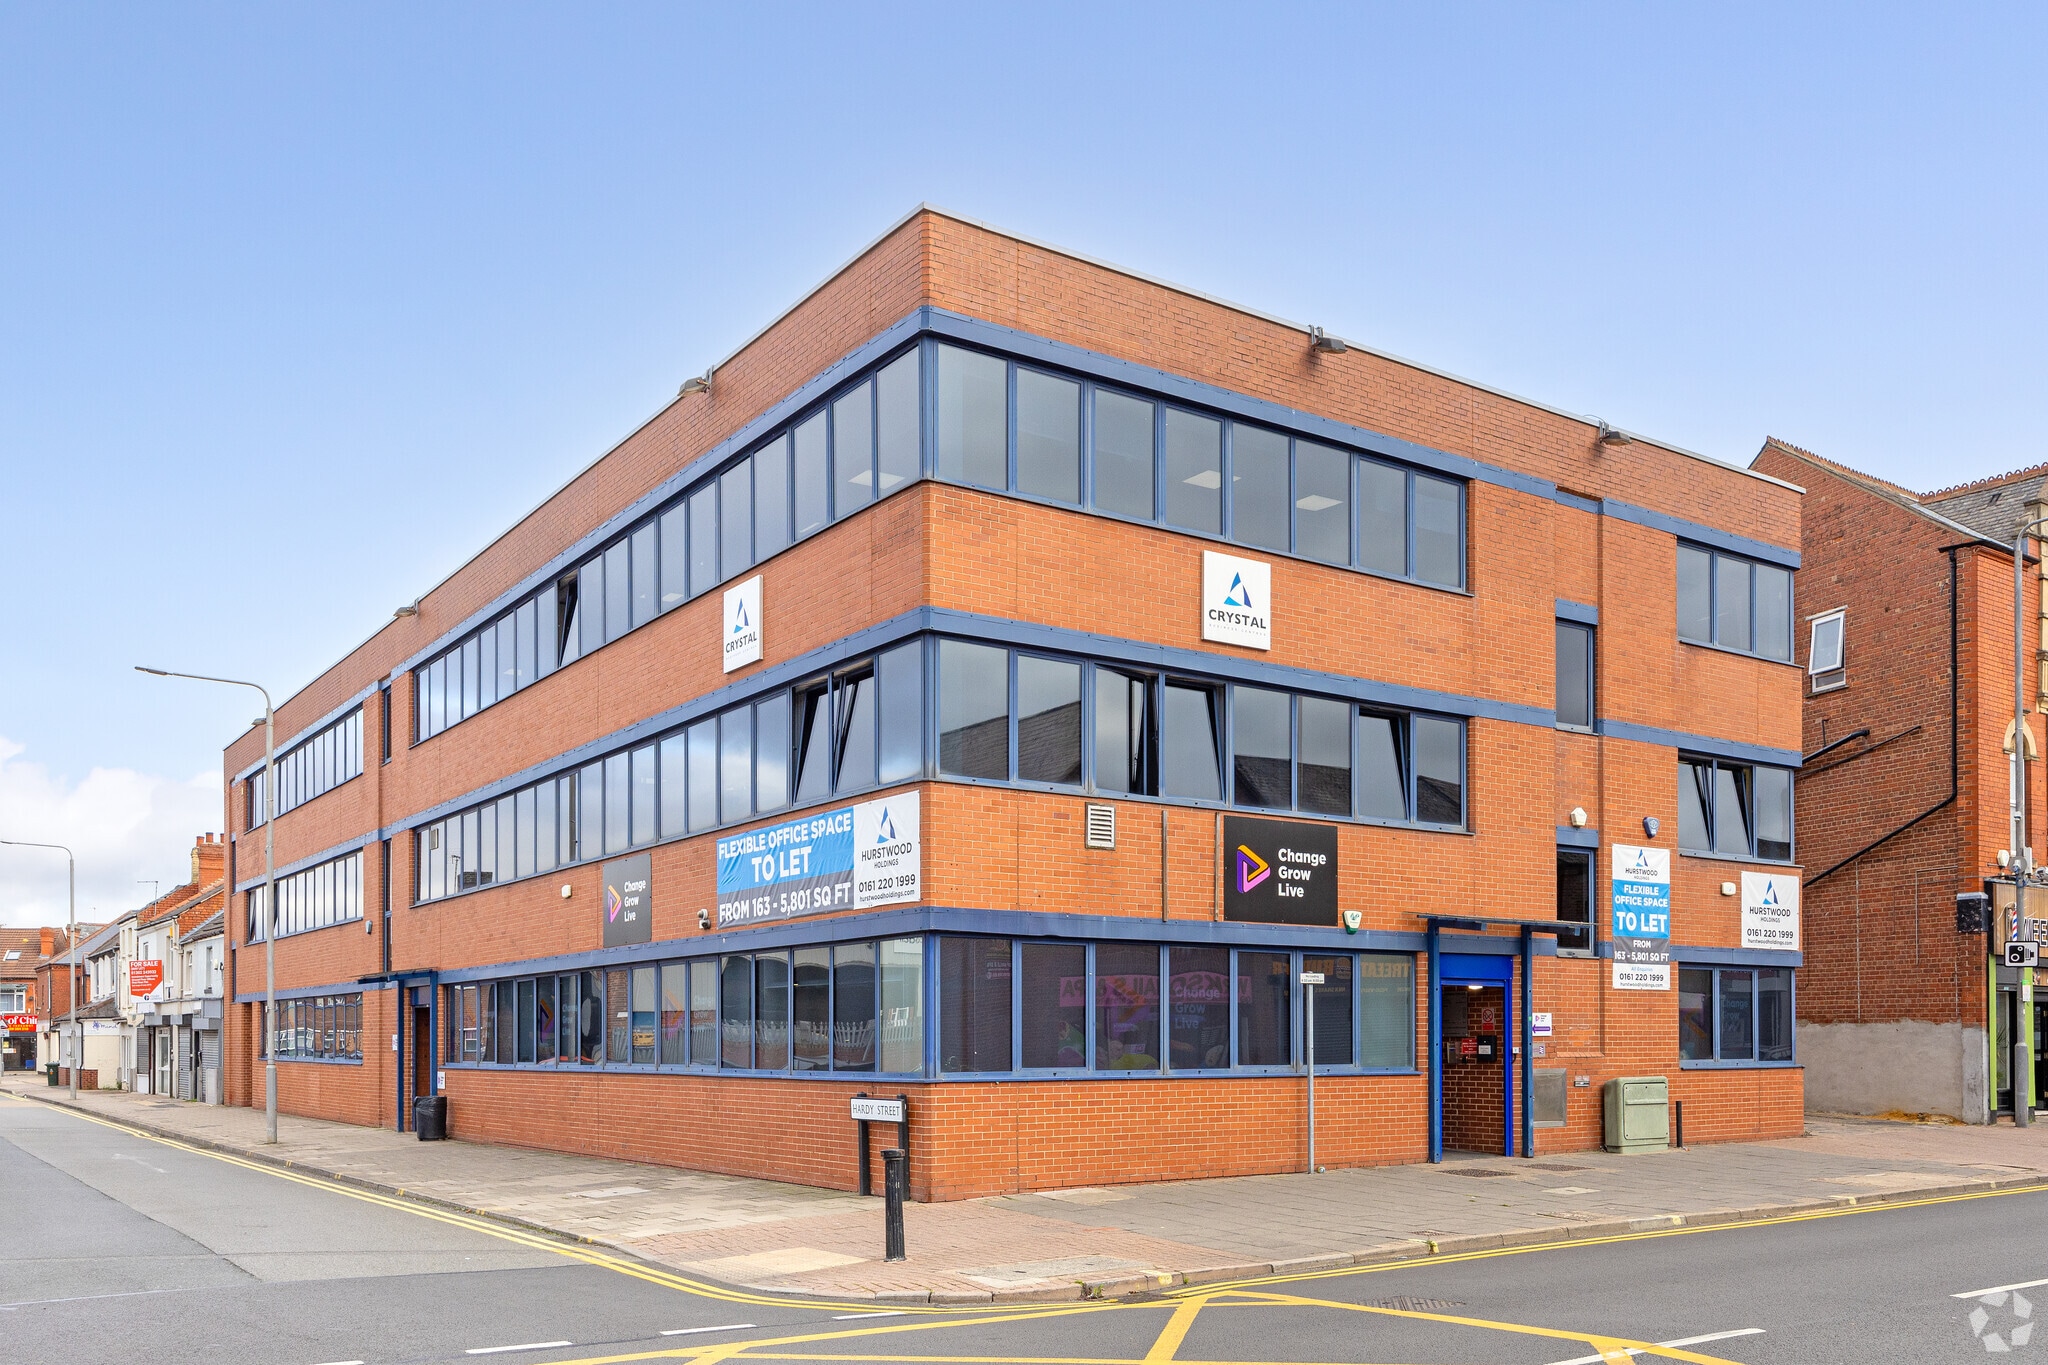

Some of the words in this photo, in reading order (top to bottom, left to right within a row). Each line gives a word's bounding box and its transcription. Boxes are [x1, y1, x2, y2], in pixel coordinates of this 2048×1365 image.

[1208, 609, 1266, 629] CRYSTAL
[726, 631, 757, 653] CRYSTAL
[718, 832, 765, 860] FLEXIBLE
[768, 823, 808, 849] OFFICE
[810, 813, 851, 839] SPACE
[861, 842, 912, 862] HURSTWOOD
[1278, 848, 1326, 866] Change
[752, 855, 774, 883] TO
[779, 846, 812, 878] LET
[874, 858, 899, 869] HOLDINGS
[1278, 866, 1311, 880] Grow
[1625, 868, 1658, 877] HURSTWOOD
[624, 880, 646, 893] Change
[858, 880, 876, 893] 0161
[878, 876, 893, 890] 220
[896, 874, 916, 887] 1999
[859, 889, 915, 903] hurstwoodholdings.com
[1278, 883, 1304, 898] Live
[1624, 884, 1659, 896] FLEXIBLE
[624, 896, 640, 908] Grow
[719, 899, 750, 923] FROM
[752, 895, 770, 917] 163
[780, 888, 811, 916] 5,801
[813, 886, 832, 907] SQ
[834, 882, 851, 905] FT
[1615, 896, 1642, 906] OFFICE
[1643, 898, 1668, 908] SPACE
[624, 910, 636, 922] Live
[1750, 906, 1790, 916] HURSTWOOD
[1616, 912, 1637, 931] TO
[1641, 914, 1667, 932] LET
[1747, 928, 1762, 936] 0161
[1764, 930, 1776, 938] 220
[1778, 930, 1794, 938] 1999
[1633, 940, 1651, 948] FROM
[1614, 951, 1626, 961] 163
[1632, 952, 1649, 962] 5,801
[1650, 952, 1660, 962] SQ
[1661, 953, 1669, 962] FT
[1620, 972, 1634, 980] 0161
[1650, 974, 1664, 982] 1999
[1175, 986, 1220, 1000] Change
[1175, 1003, 1206, 1014] Grow
[8, 1016, 18, 1025] of
[1175, 1018, 1199, 1030] Live
[852, 1104, 874, 1114] HARDY
[877, 1105, 900, 1116] STREET
